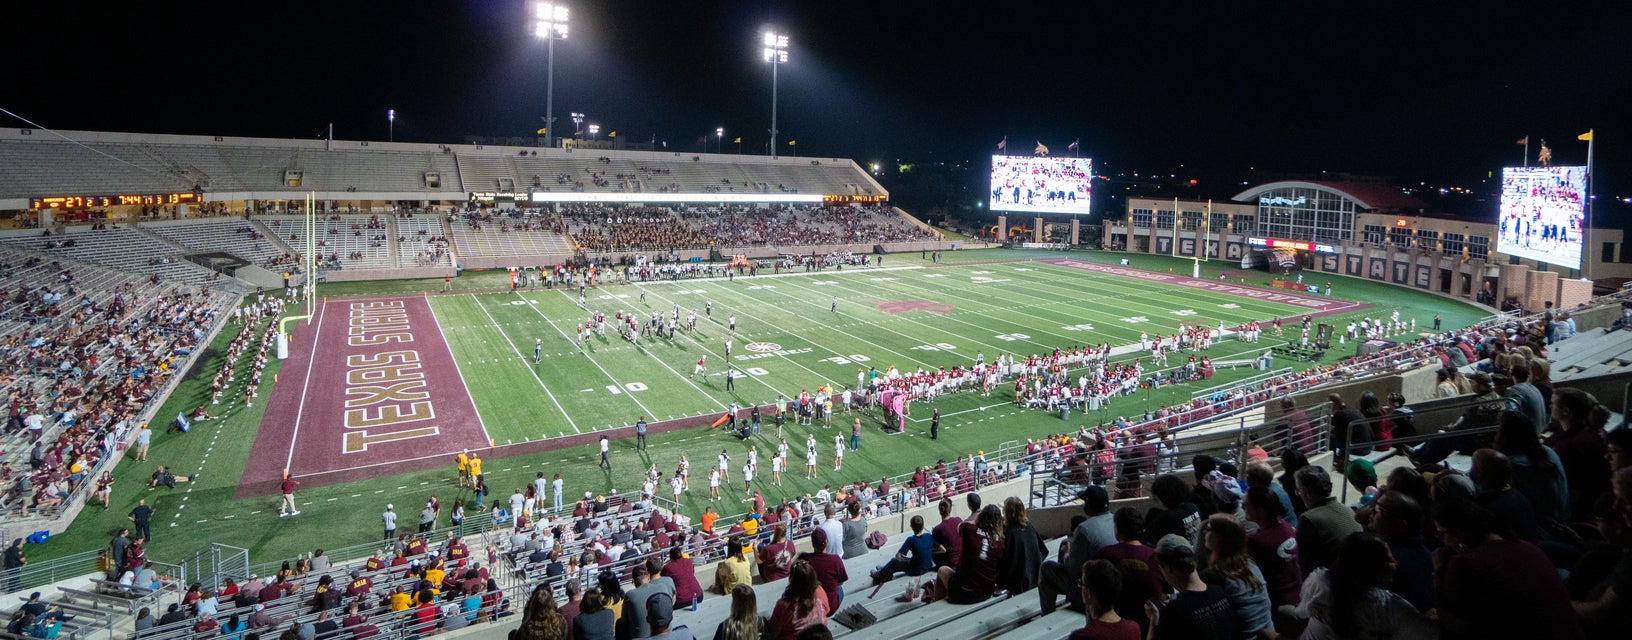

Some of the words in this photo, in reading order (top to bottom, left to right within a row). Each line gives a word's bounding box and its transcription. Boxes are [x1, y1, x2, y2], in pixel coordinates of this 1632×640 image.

[66, 197, 82, 208] 27
[86, 199, 93, 207] 2
[119, 196, 141, 204] 7:44
[169, 194, 178, 203] 13
[1159, 238, 1241, 259] TEXA
[1324, 255, 1429, 288] STATE
[347, 300, 414, 346] STATE
[774, 347, 813, 356] BELT
[827, 353, 871, 365] 30
[605, 382, 648, 394] 10
[343, 350, 440, 454] TEXAS
